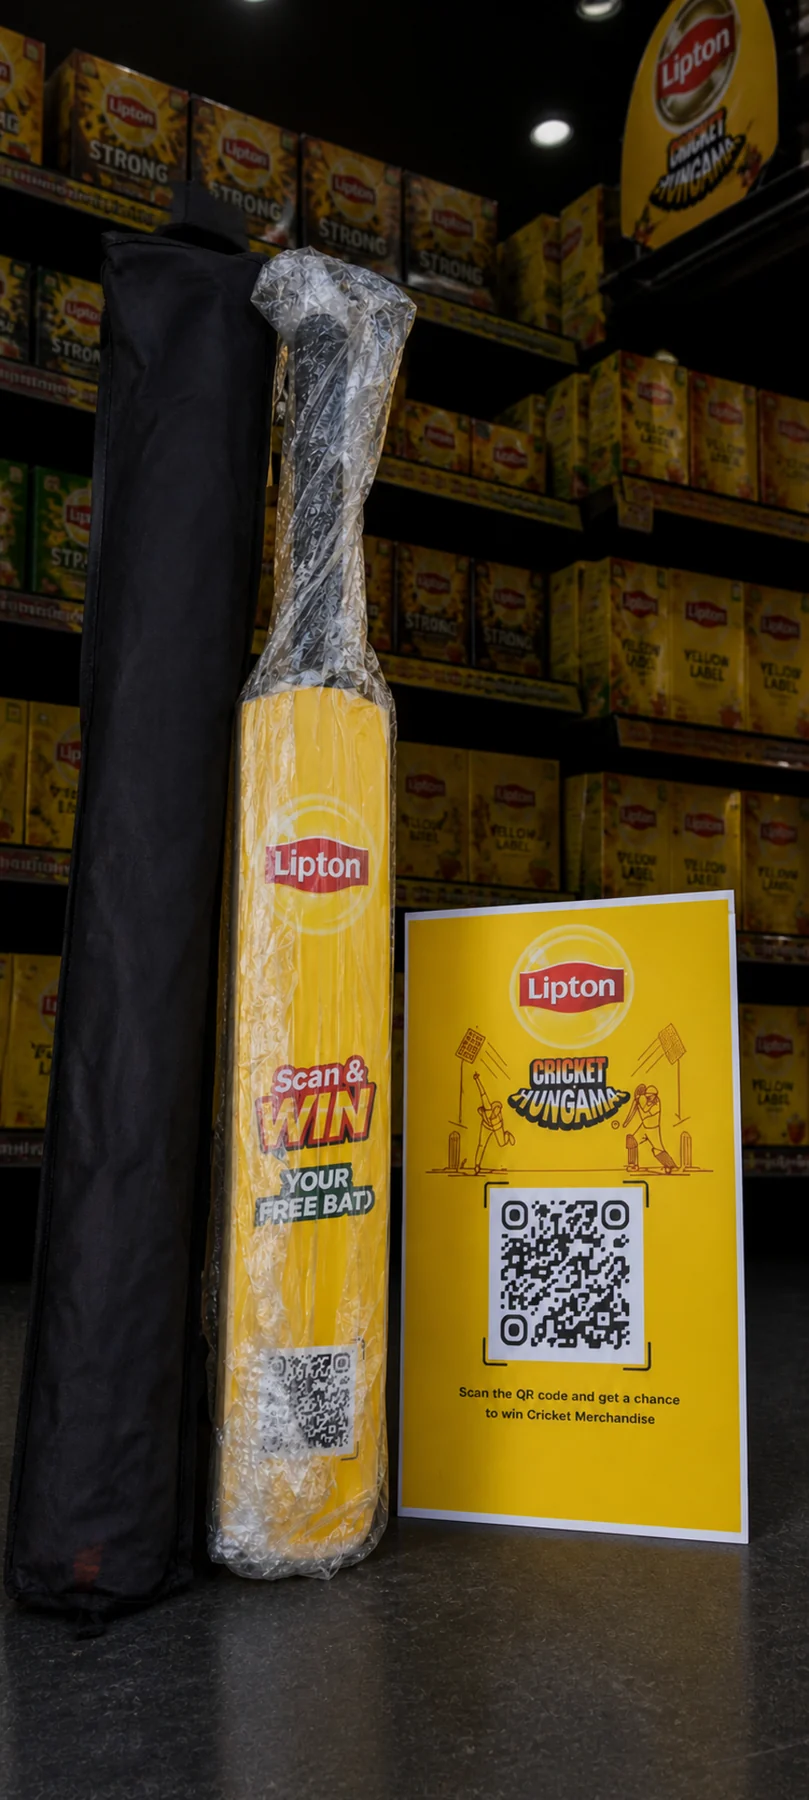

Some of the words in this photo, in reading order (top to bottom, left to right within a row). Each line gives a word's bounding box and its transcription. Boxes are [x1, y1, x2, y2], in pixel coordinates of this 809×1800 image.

[661, 27, 730, 89] Lipton
[108, 98, 154, 126] Lipton
[89, 139, 168, 183] STRONG
[225, 141, 267, 165] Lipton
[335, 177, 374, 203] Lipton
[319, 218, 387, 255] STRONG
[434, 211, 473, 235] Lipton
[420, 252, 484, 286] STRONG
[67, 303, 100, 321] Lipto
[52, 338, 100, 364] STRON
[275, 849, 360, 882] Lipton
[528, 976, 615, 1004] Lipton
[274, 1066, 339, 1093] Scan
[346, 1059, 364, 1083] &
[532, 1057, 606, 1085] CRICKET
[260, 1086, 372, 1149] WIN
[511, 1088, 628, 1125] HUNGAMA
[286, 1168, 350, 1194] YOUR
[259, 1196, 318, 1222] FREE
[323, 1189, 373, 1215] BAT)
[458, 1386, 489, 1399] Scan
[492, 1388, 512, 1400] the
[516, 1388, 534, 1401] QR
[537, 1390, 568, 1402] code
[571, 1391, 595, 1402] and
[598, 1392, 619, 1405] get
[623, 1394, 631, 1404] a
[633, 1393, 680, 1406] chance
[485, 1407, 498, 1419] to
[501, 1408, 523, 1420] win
[526, 1409, 571, 1422] Cricket
[575, 1411, 655, 1425] Merchandise
